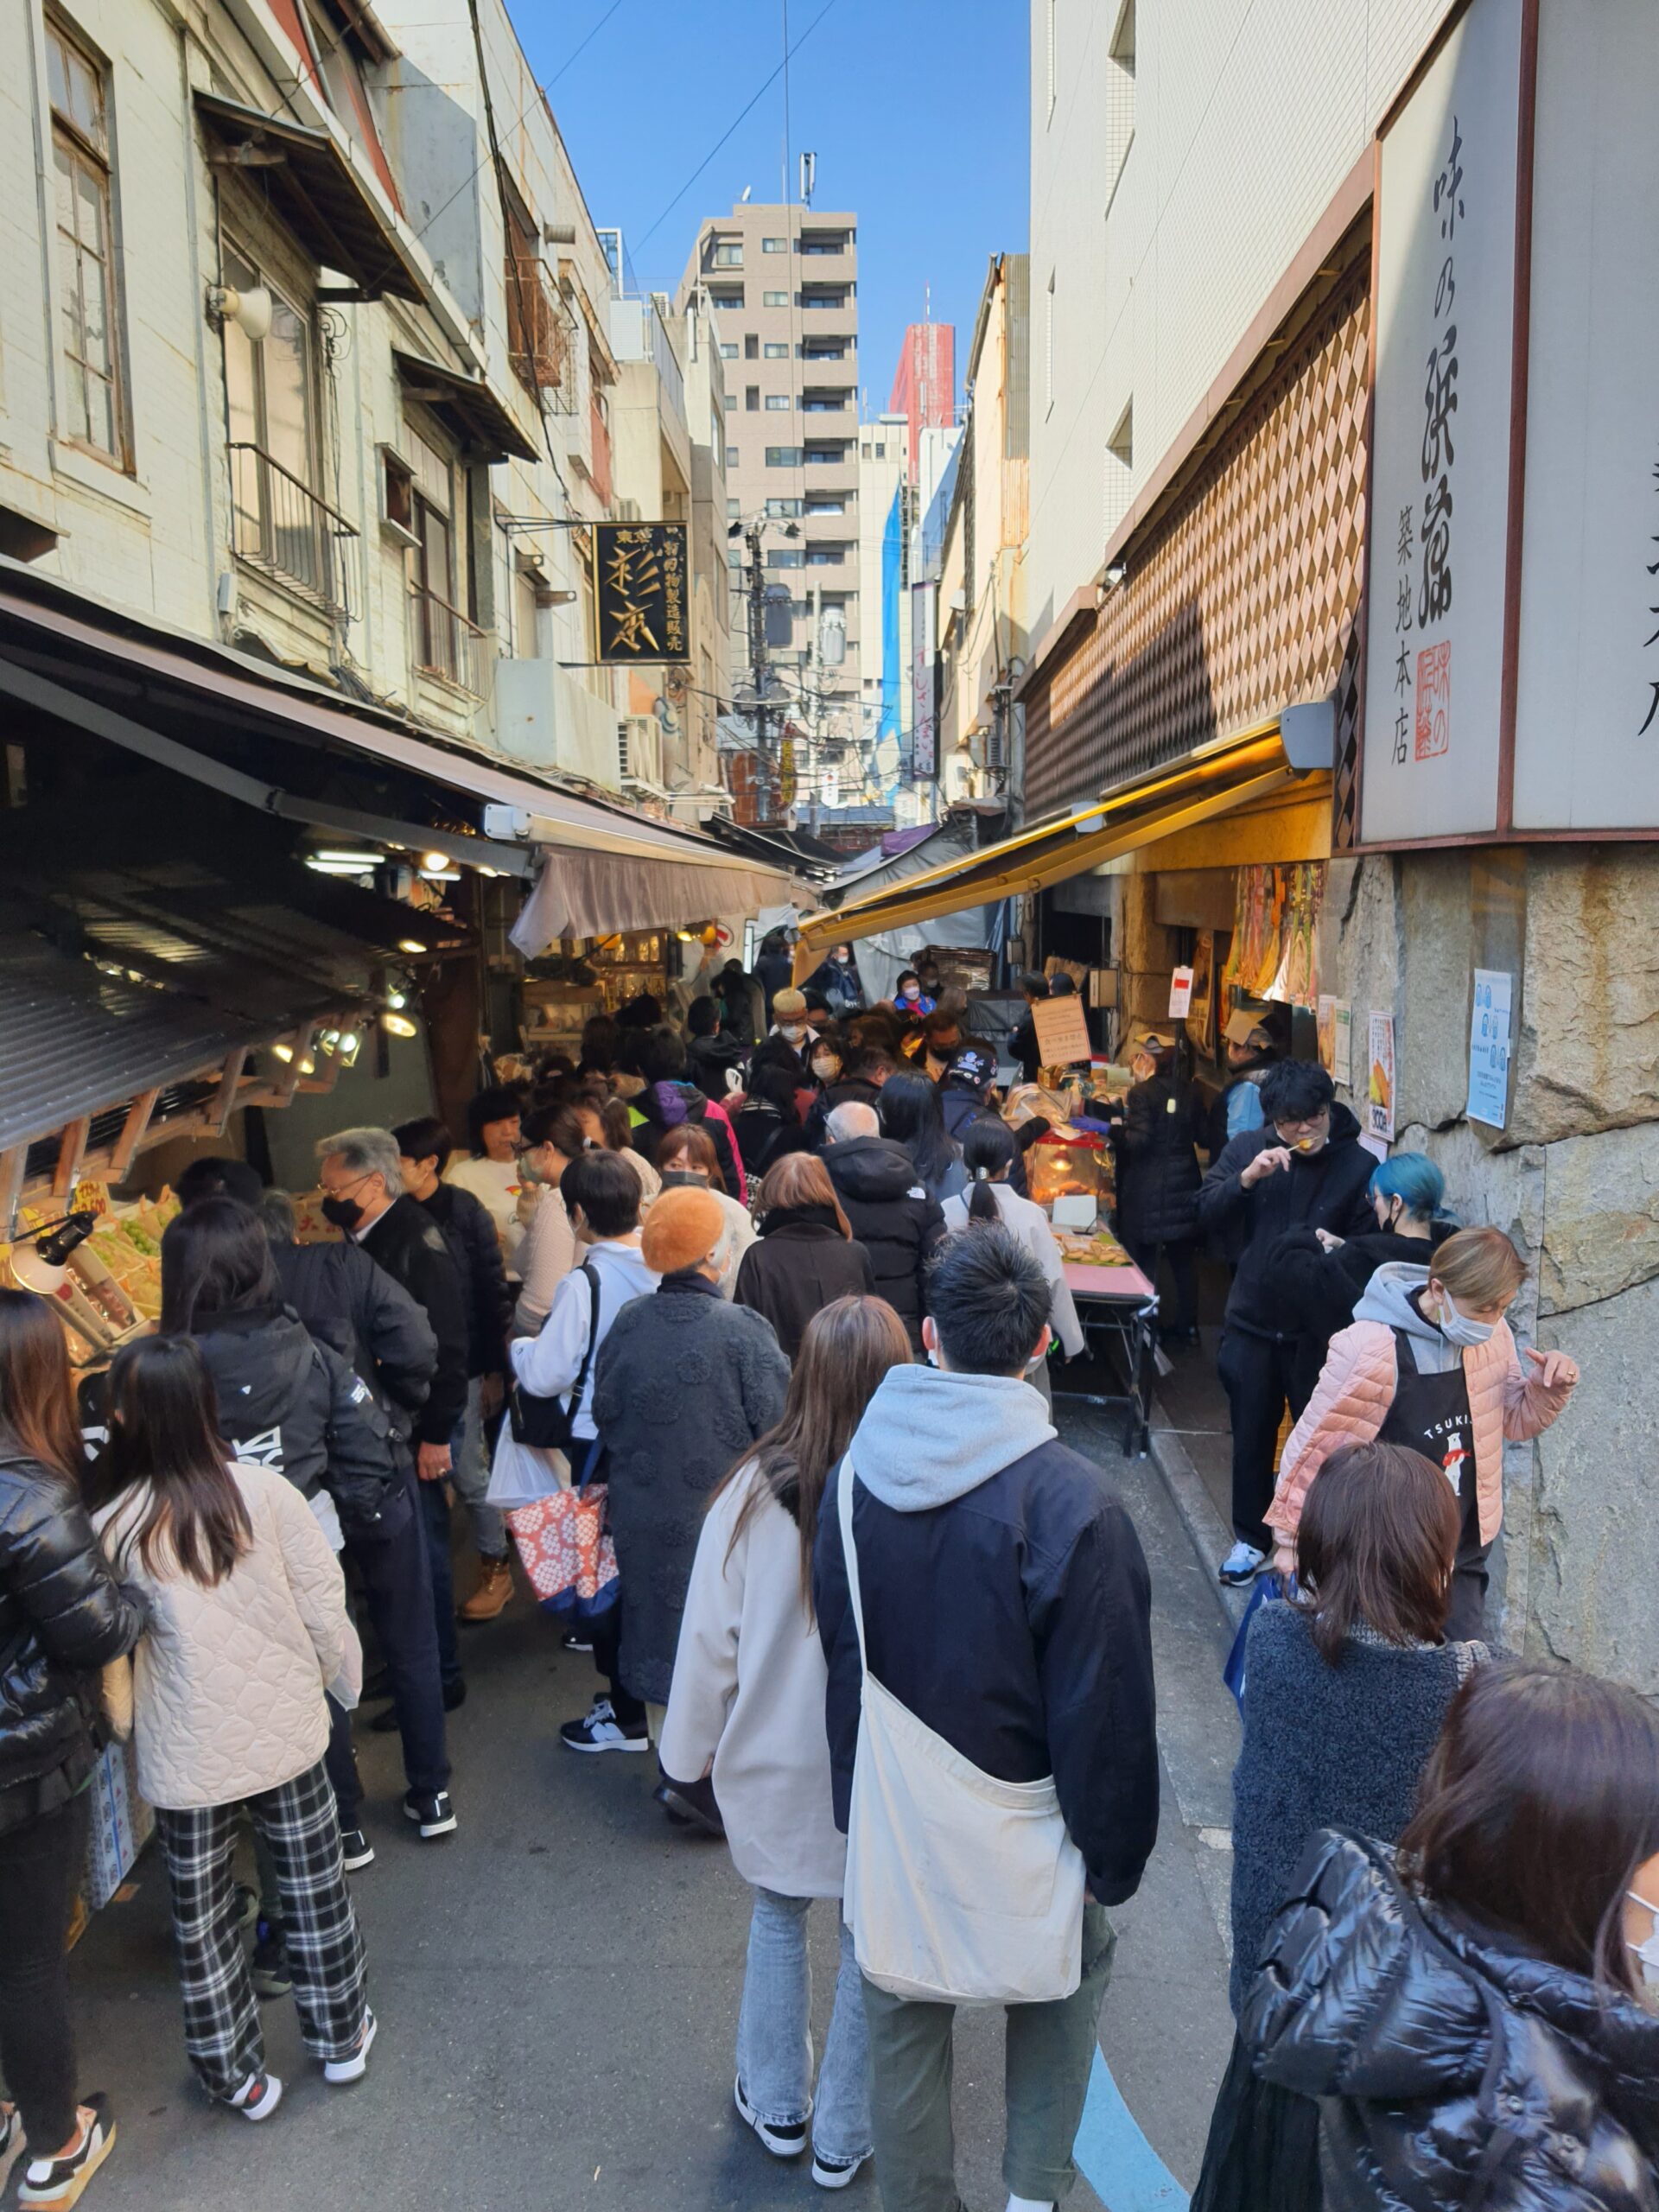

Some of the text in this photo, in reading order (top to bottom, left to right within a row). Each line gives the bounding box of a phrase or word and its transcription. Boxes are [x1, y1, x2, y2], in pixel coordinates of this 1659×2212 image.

[1391, 505, 1413, 766] 築地本店
[1424, 1414, 1472, 1440] TSUKI
